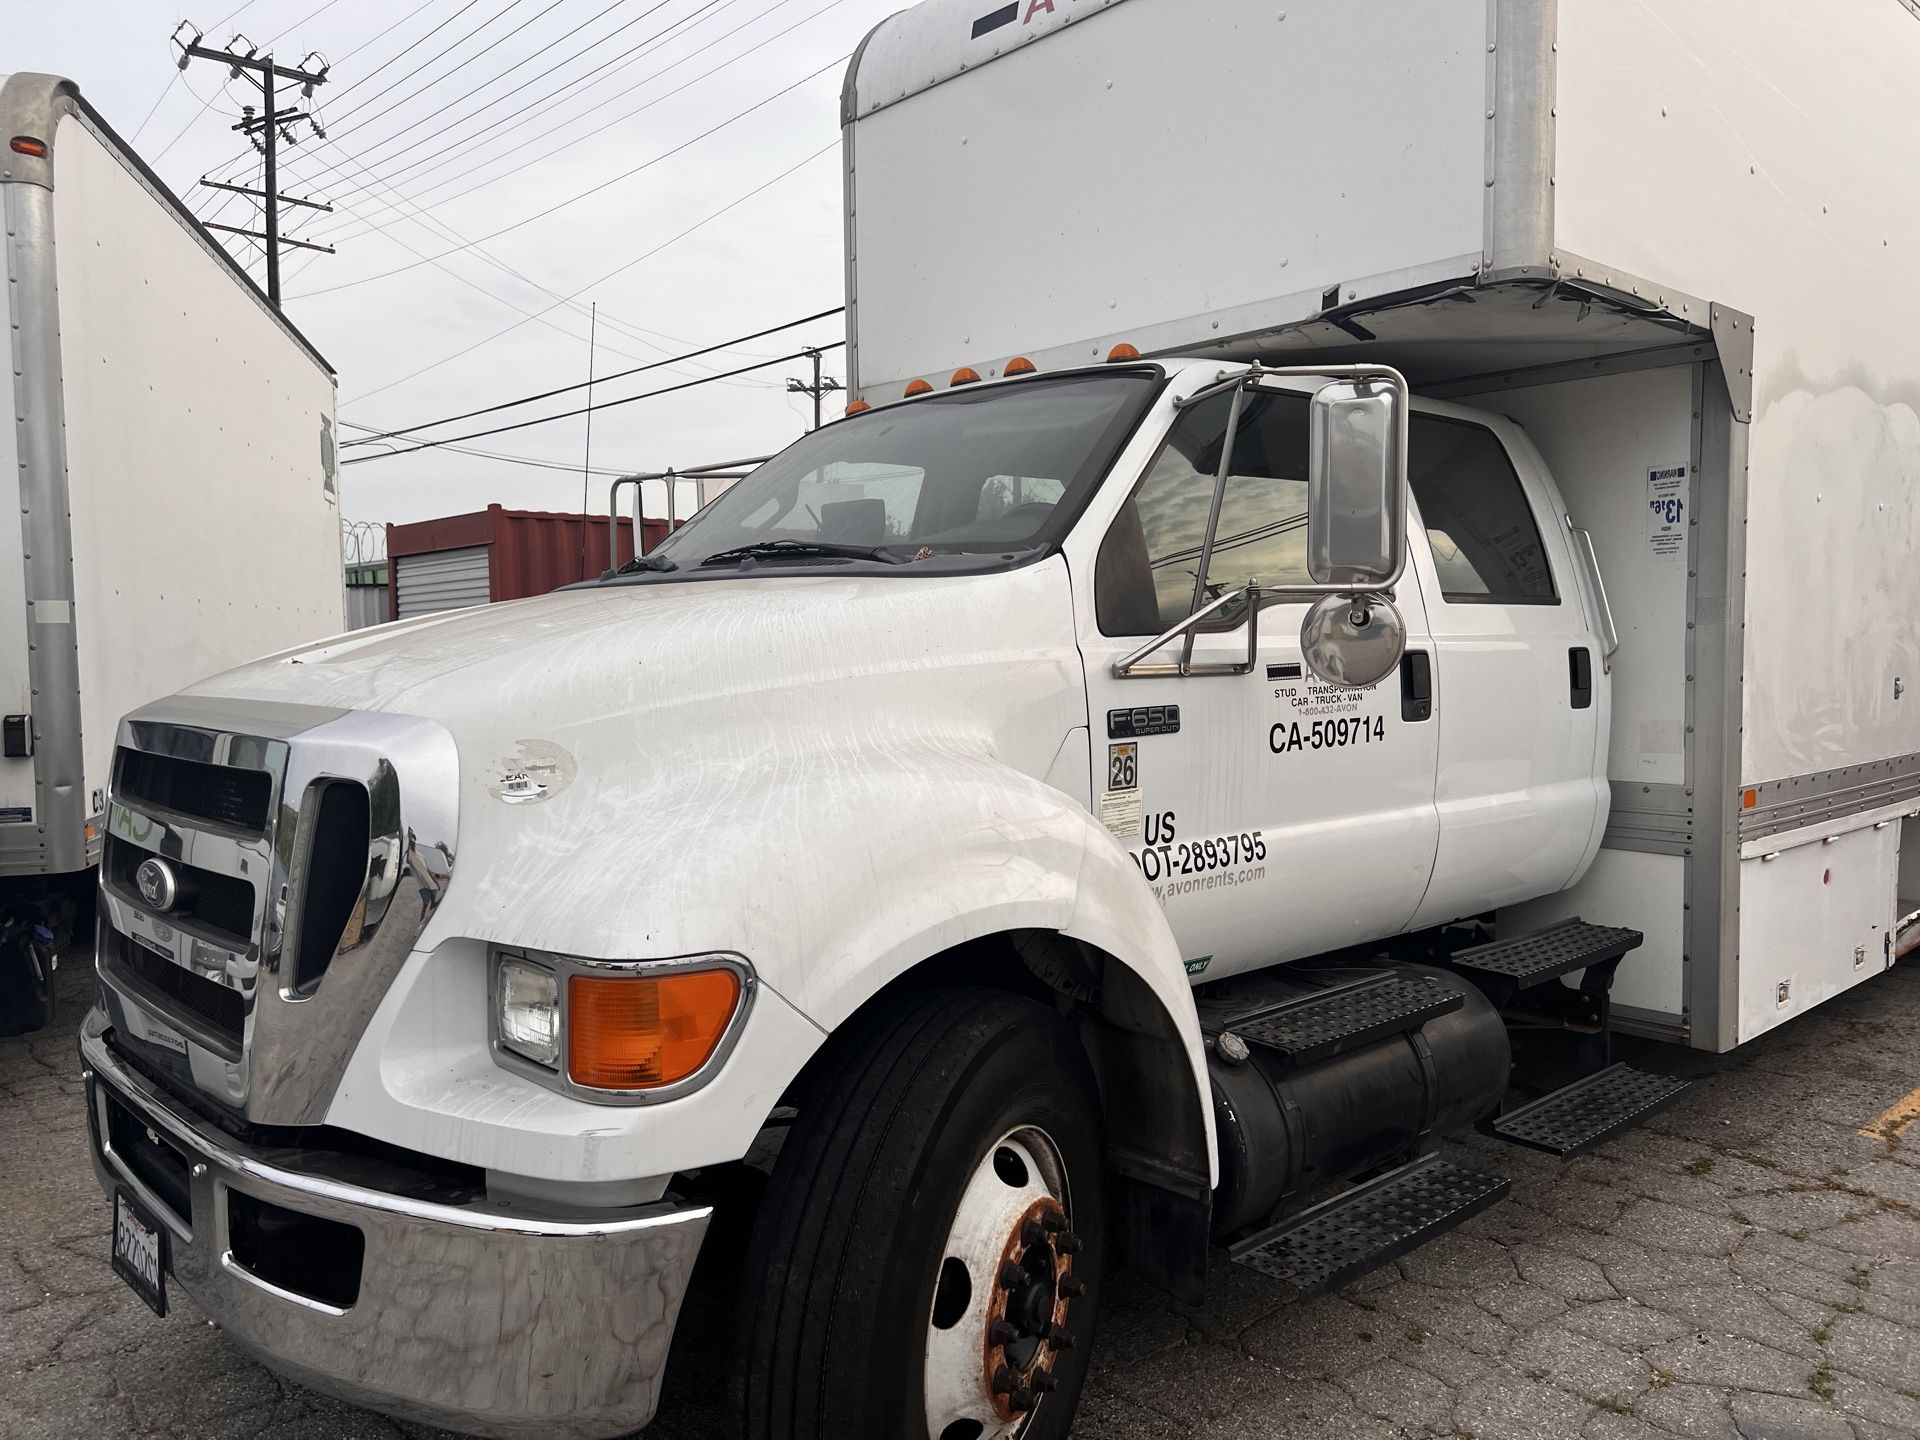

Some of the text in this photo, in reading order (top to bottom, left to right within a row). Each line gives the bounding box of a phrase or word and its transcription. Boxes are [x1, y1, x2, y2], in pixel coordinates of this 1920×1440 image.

[1274, 688, 1297, 698] STUD
[1291, 697, 1309, 707] CAR
[1315, 694, 1342, 705] TRUCK
[1347, 693, 1363, 702] VAN
[1135, 727, 1160, 735] SUPER
[1269, 715, 1385, 754] CA-509714
[1112, 755, 1134, 787] 26
[1144, 811, 1176, 846] US
